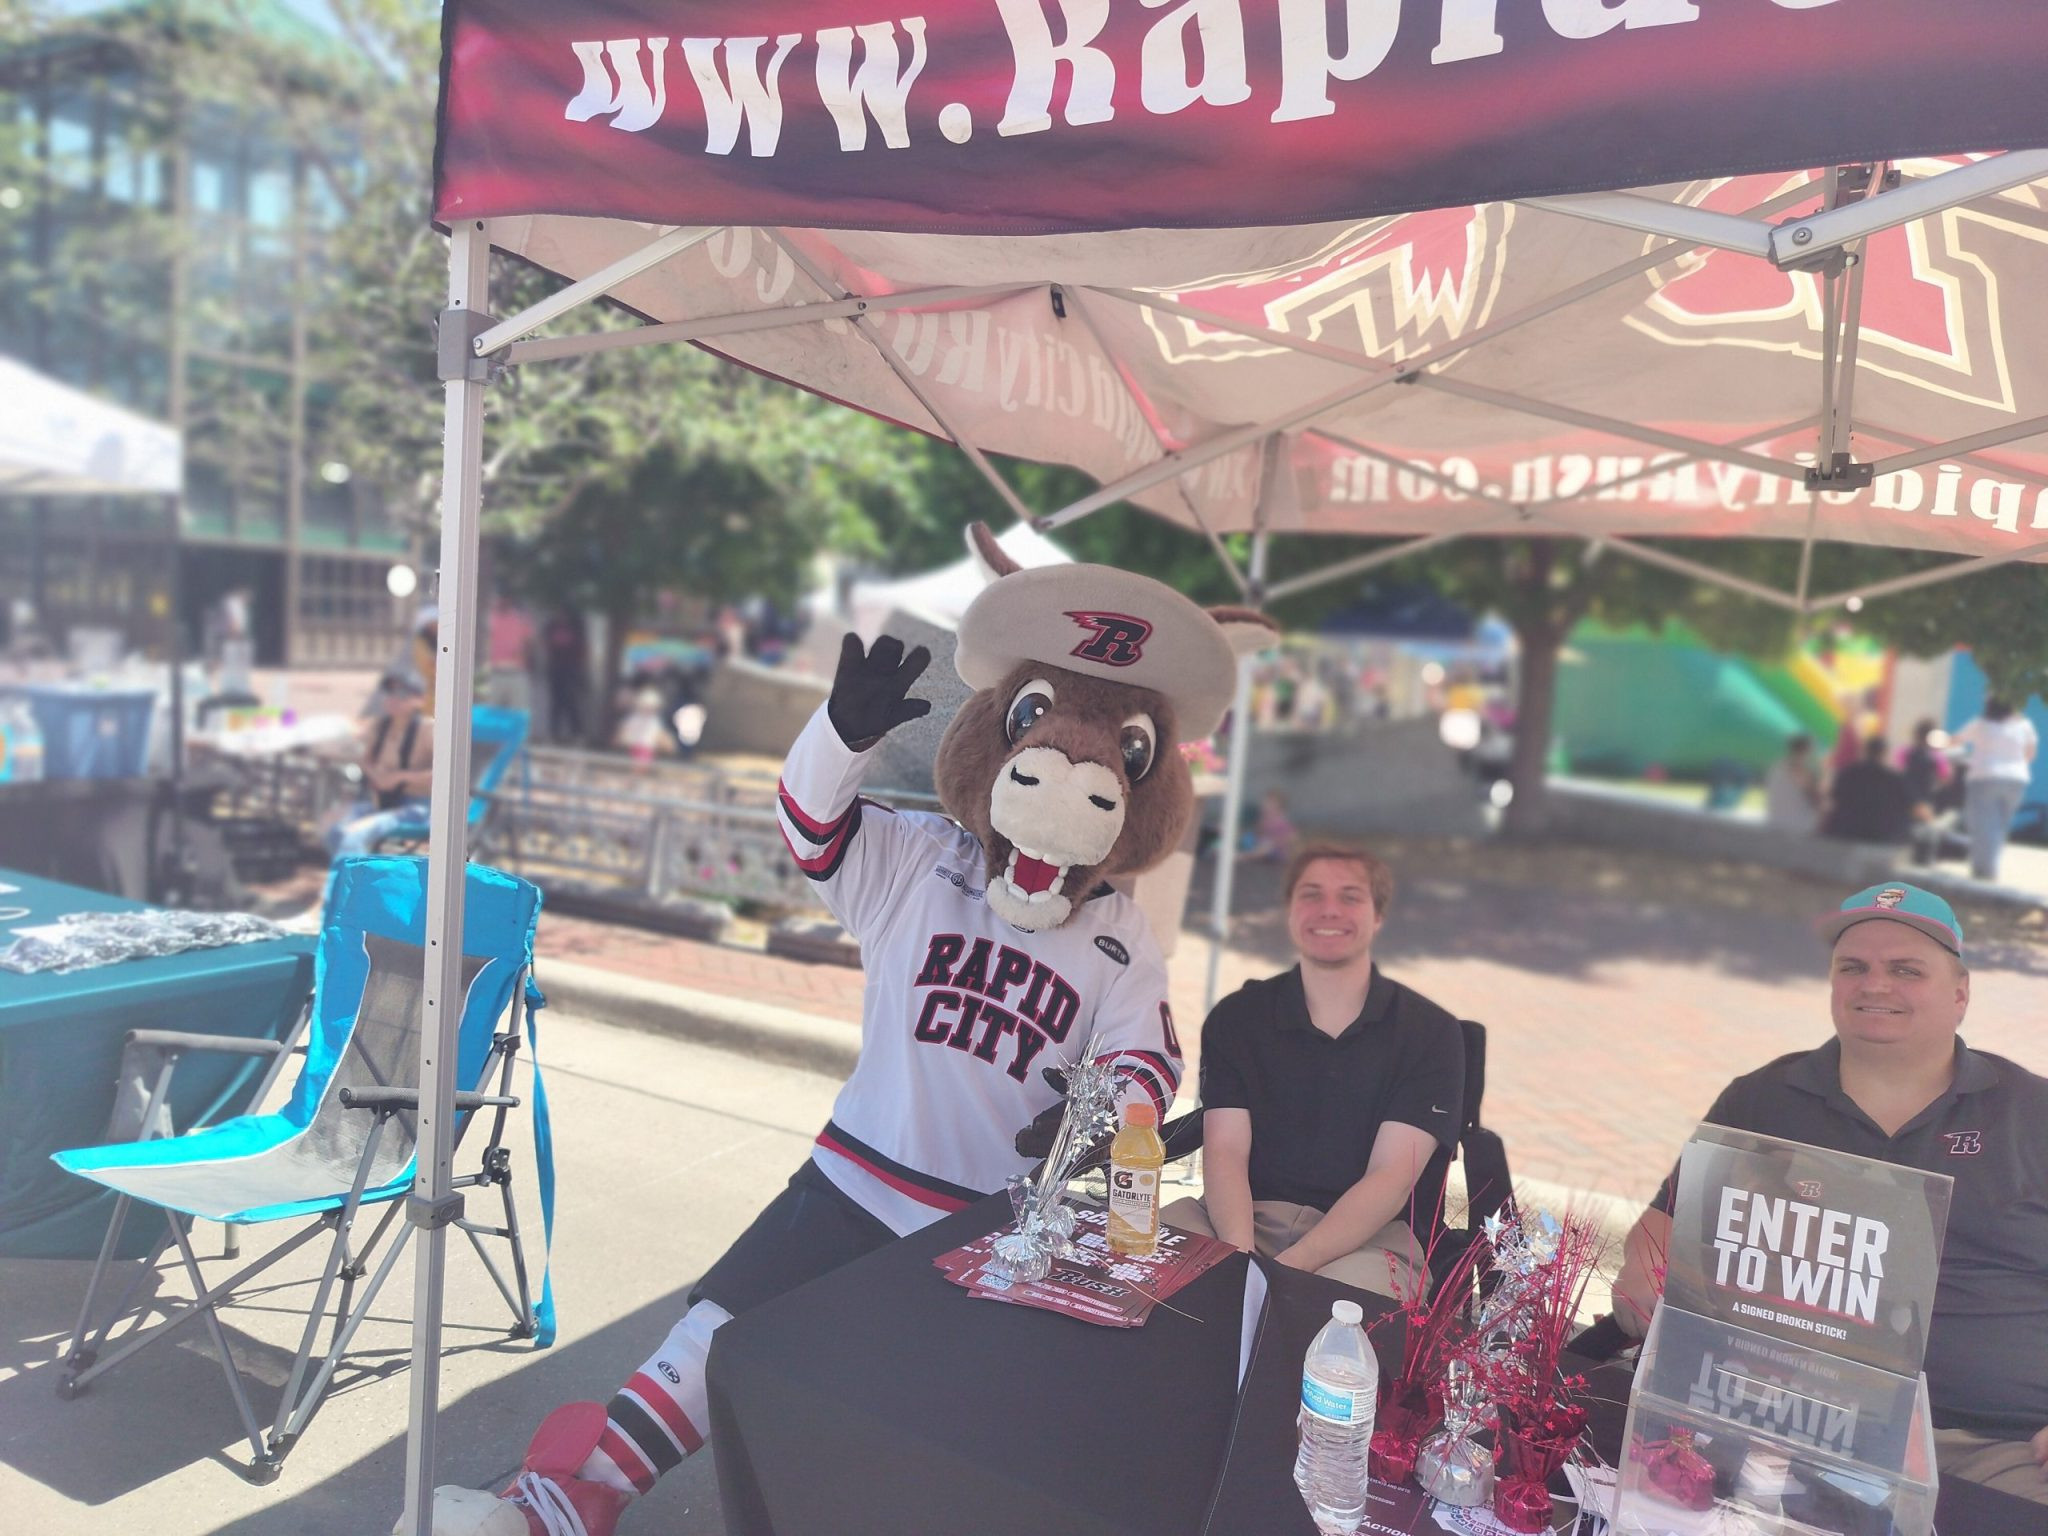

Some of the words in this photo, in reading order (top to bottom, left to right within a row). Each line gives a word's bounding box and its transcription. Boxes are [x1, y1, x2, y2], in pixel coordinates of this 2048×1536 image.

[914, 934, 1080, 1044] RAPID
[914, 989, 1048, 1084] CITY
[1112, 1189, 1152, 1202] GATORLYTE
[1114, 1171, 1133, 1189] G
[1716, 1186, 1890, 1278] ENTER
[1714, 1239, 1767, 1294] TO
[1781, 1255, 1880, 1324] WIN
[1732, 1302, 1740, 1312] A
[1740, 1303, 1775, 1321] SIGNED
[1776, 1313, 1814, 1332] BROKEN
[1815, 1323, 1848, 1340] STICK!
[1323, 1397, 1347, 1411] Water
